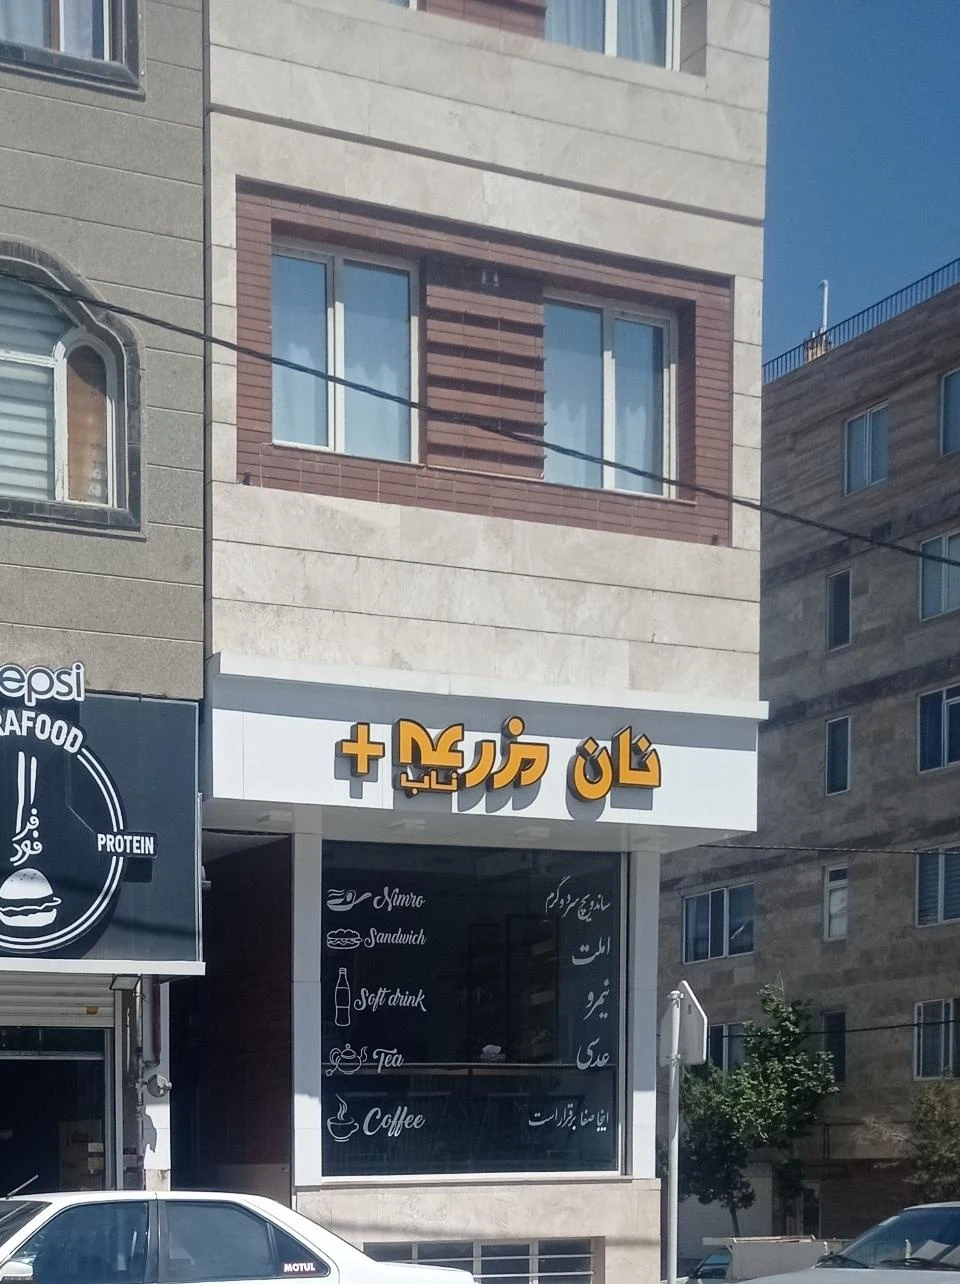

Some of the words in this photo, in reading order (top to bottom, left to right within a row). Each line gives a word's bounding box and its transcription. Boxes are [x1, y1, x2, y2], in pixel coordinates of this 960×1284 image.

[569, 725, 661, 800] نان
[400, 768, 458, 797] ناب
[9, 830, 43, 867] فود
[96, 832, 155, 855] PROTEIN
[373, 886, 426, 911] Nimro
[545, 874, 571, 916] گرم
[577, 893, 611, 922] ساندویچ
[363, 927, 427, 949] Sandwich
[572, 935, 611, 966] املت
[353, 987, 391, 1012] Soft
[388, 989, 427, 1012] drink
[583, 978, 610, 1020] نیمرو
[372, 1048, 404, 1073] Tea
[576, 1037, 610, 1070] عدسی
[362, 1106, 426, 1137] Coffee
[528, 1108, 558, 1127] است
[283, 1262, 316, 1273] MOTUL
